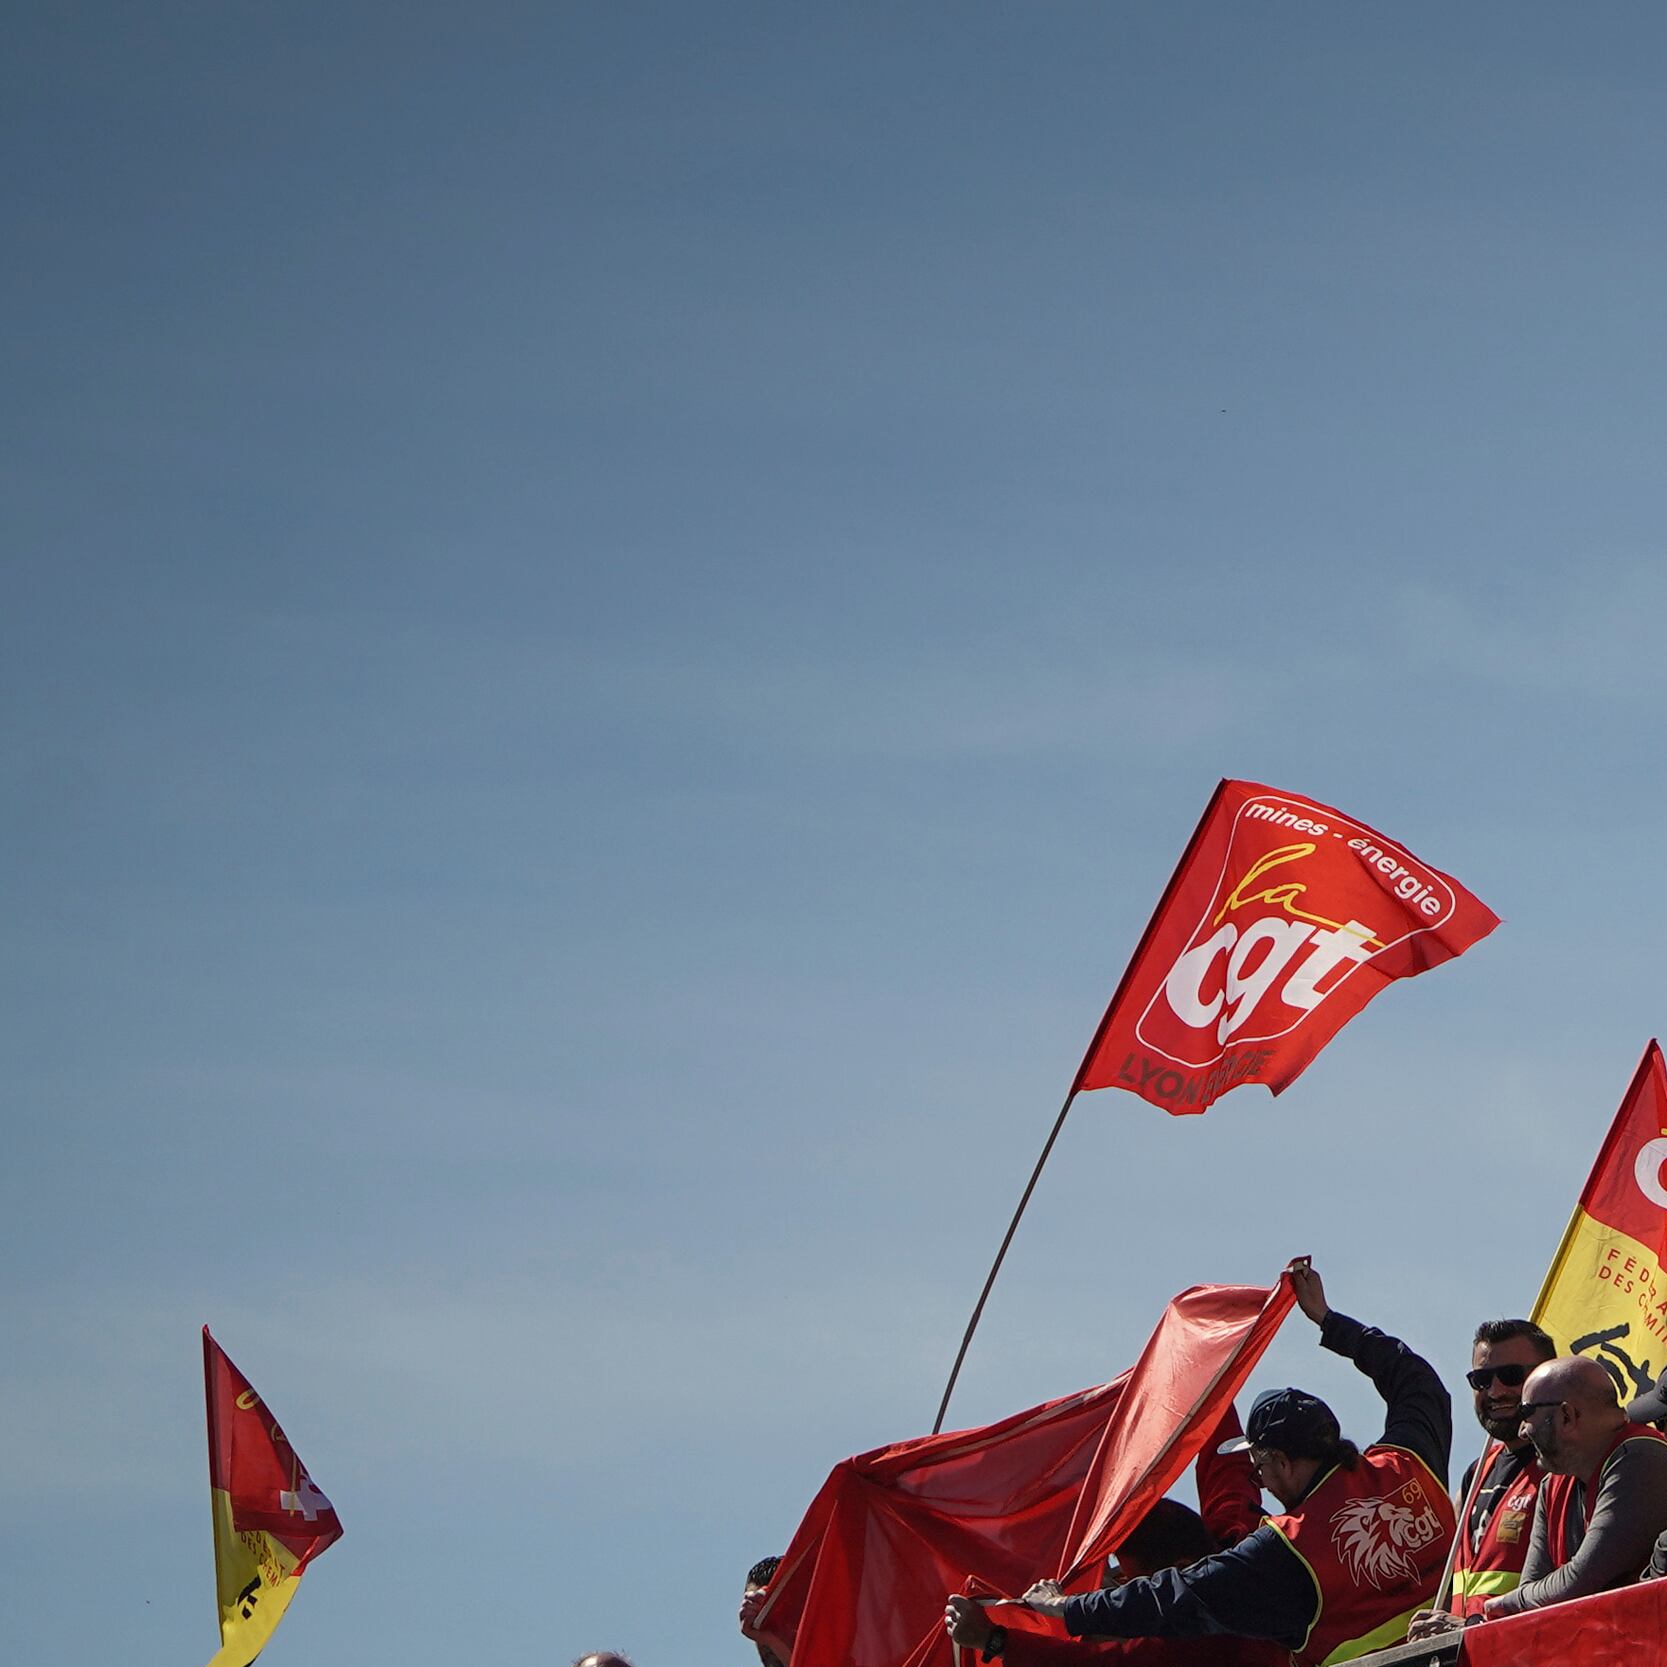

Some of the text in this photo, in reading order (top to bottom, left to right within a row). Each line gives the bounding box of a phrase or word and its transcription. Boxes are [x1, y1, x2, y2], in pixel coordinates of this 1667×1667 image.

[1245, 800, 1329, 836] mines
[1347, 836, 1442, 918] énergie
[1213, 843, 1388, 949] la
[1165, 916, 1380, 1046] cgt
[1598, 1265, 1634, 1294] DES
[1401, 1481, 1422, 1505] 69
[1507, 1493, 1533, 1511] cgt
[1404, 1505, 1441, 1548] cgt
